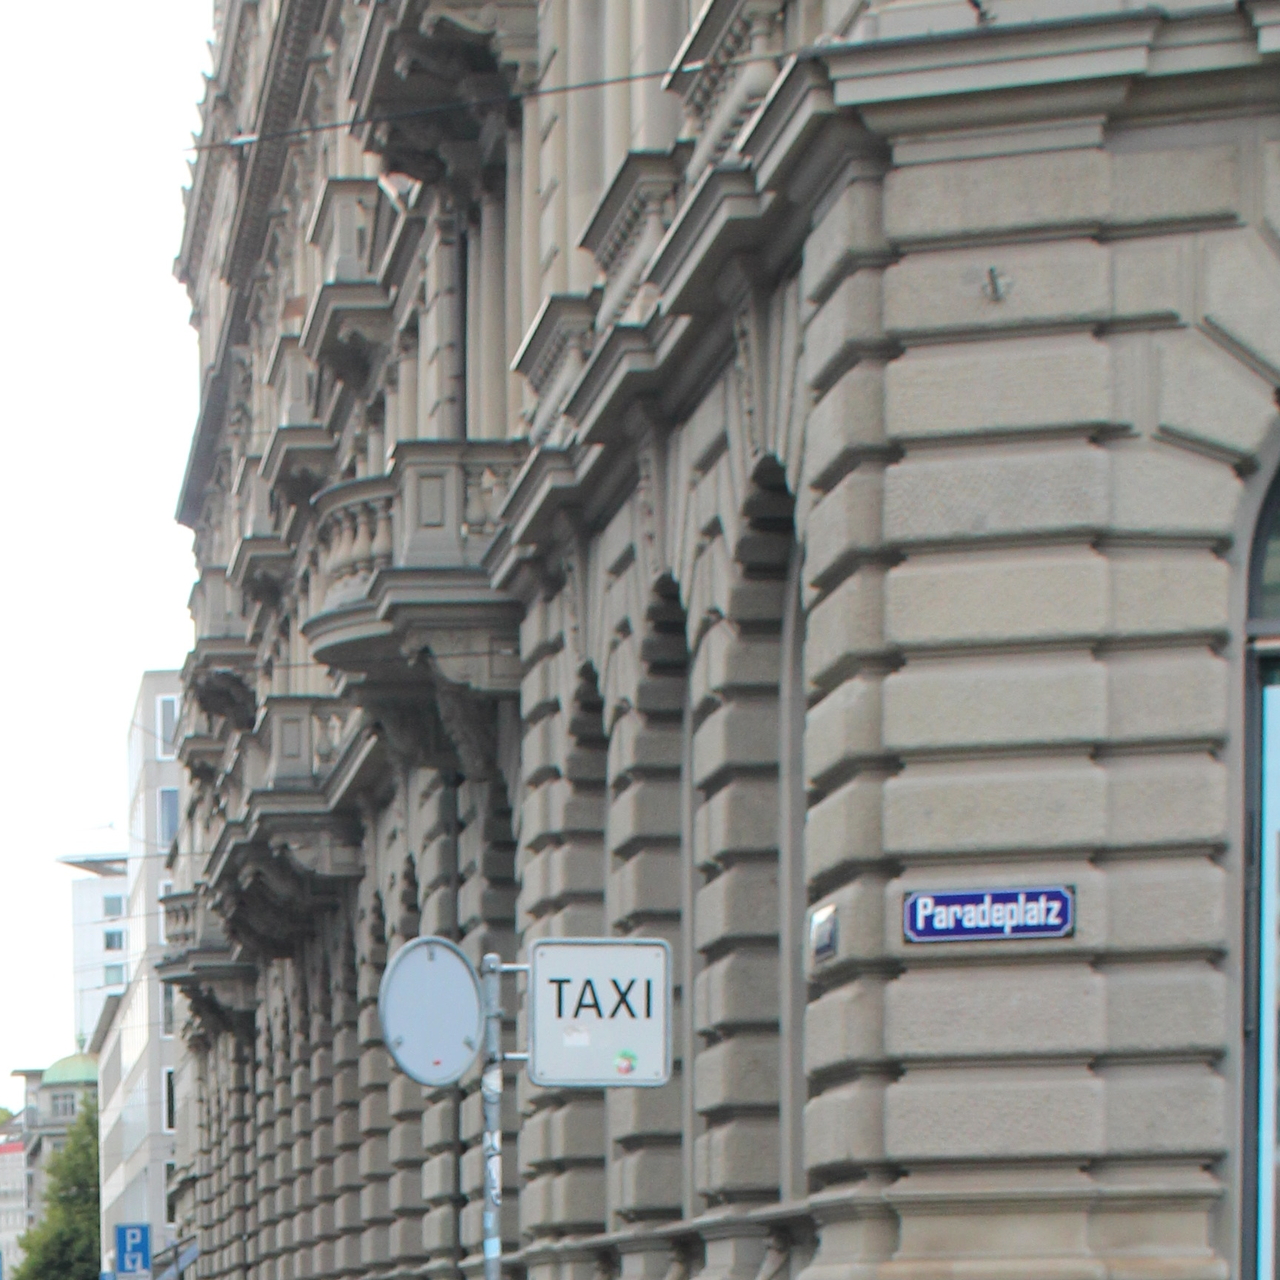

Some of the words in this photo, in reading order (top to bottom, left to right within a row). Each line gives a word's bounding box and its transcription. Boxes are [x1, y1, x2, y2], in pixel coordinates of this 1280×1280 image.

[915, 893, 1063, 935] Paradeplatz
[548, 978, 653, 1018] TAXI
[125, 1228, 142, 1253] P
